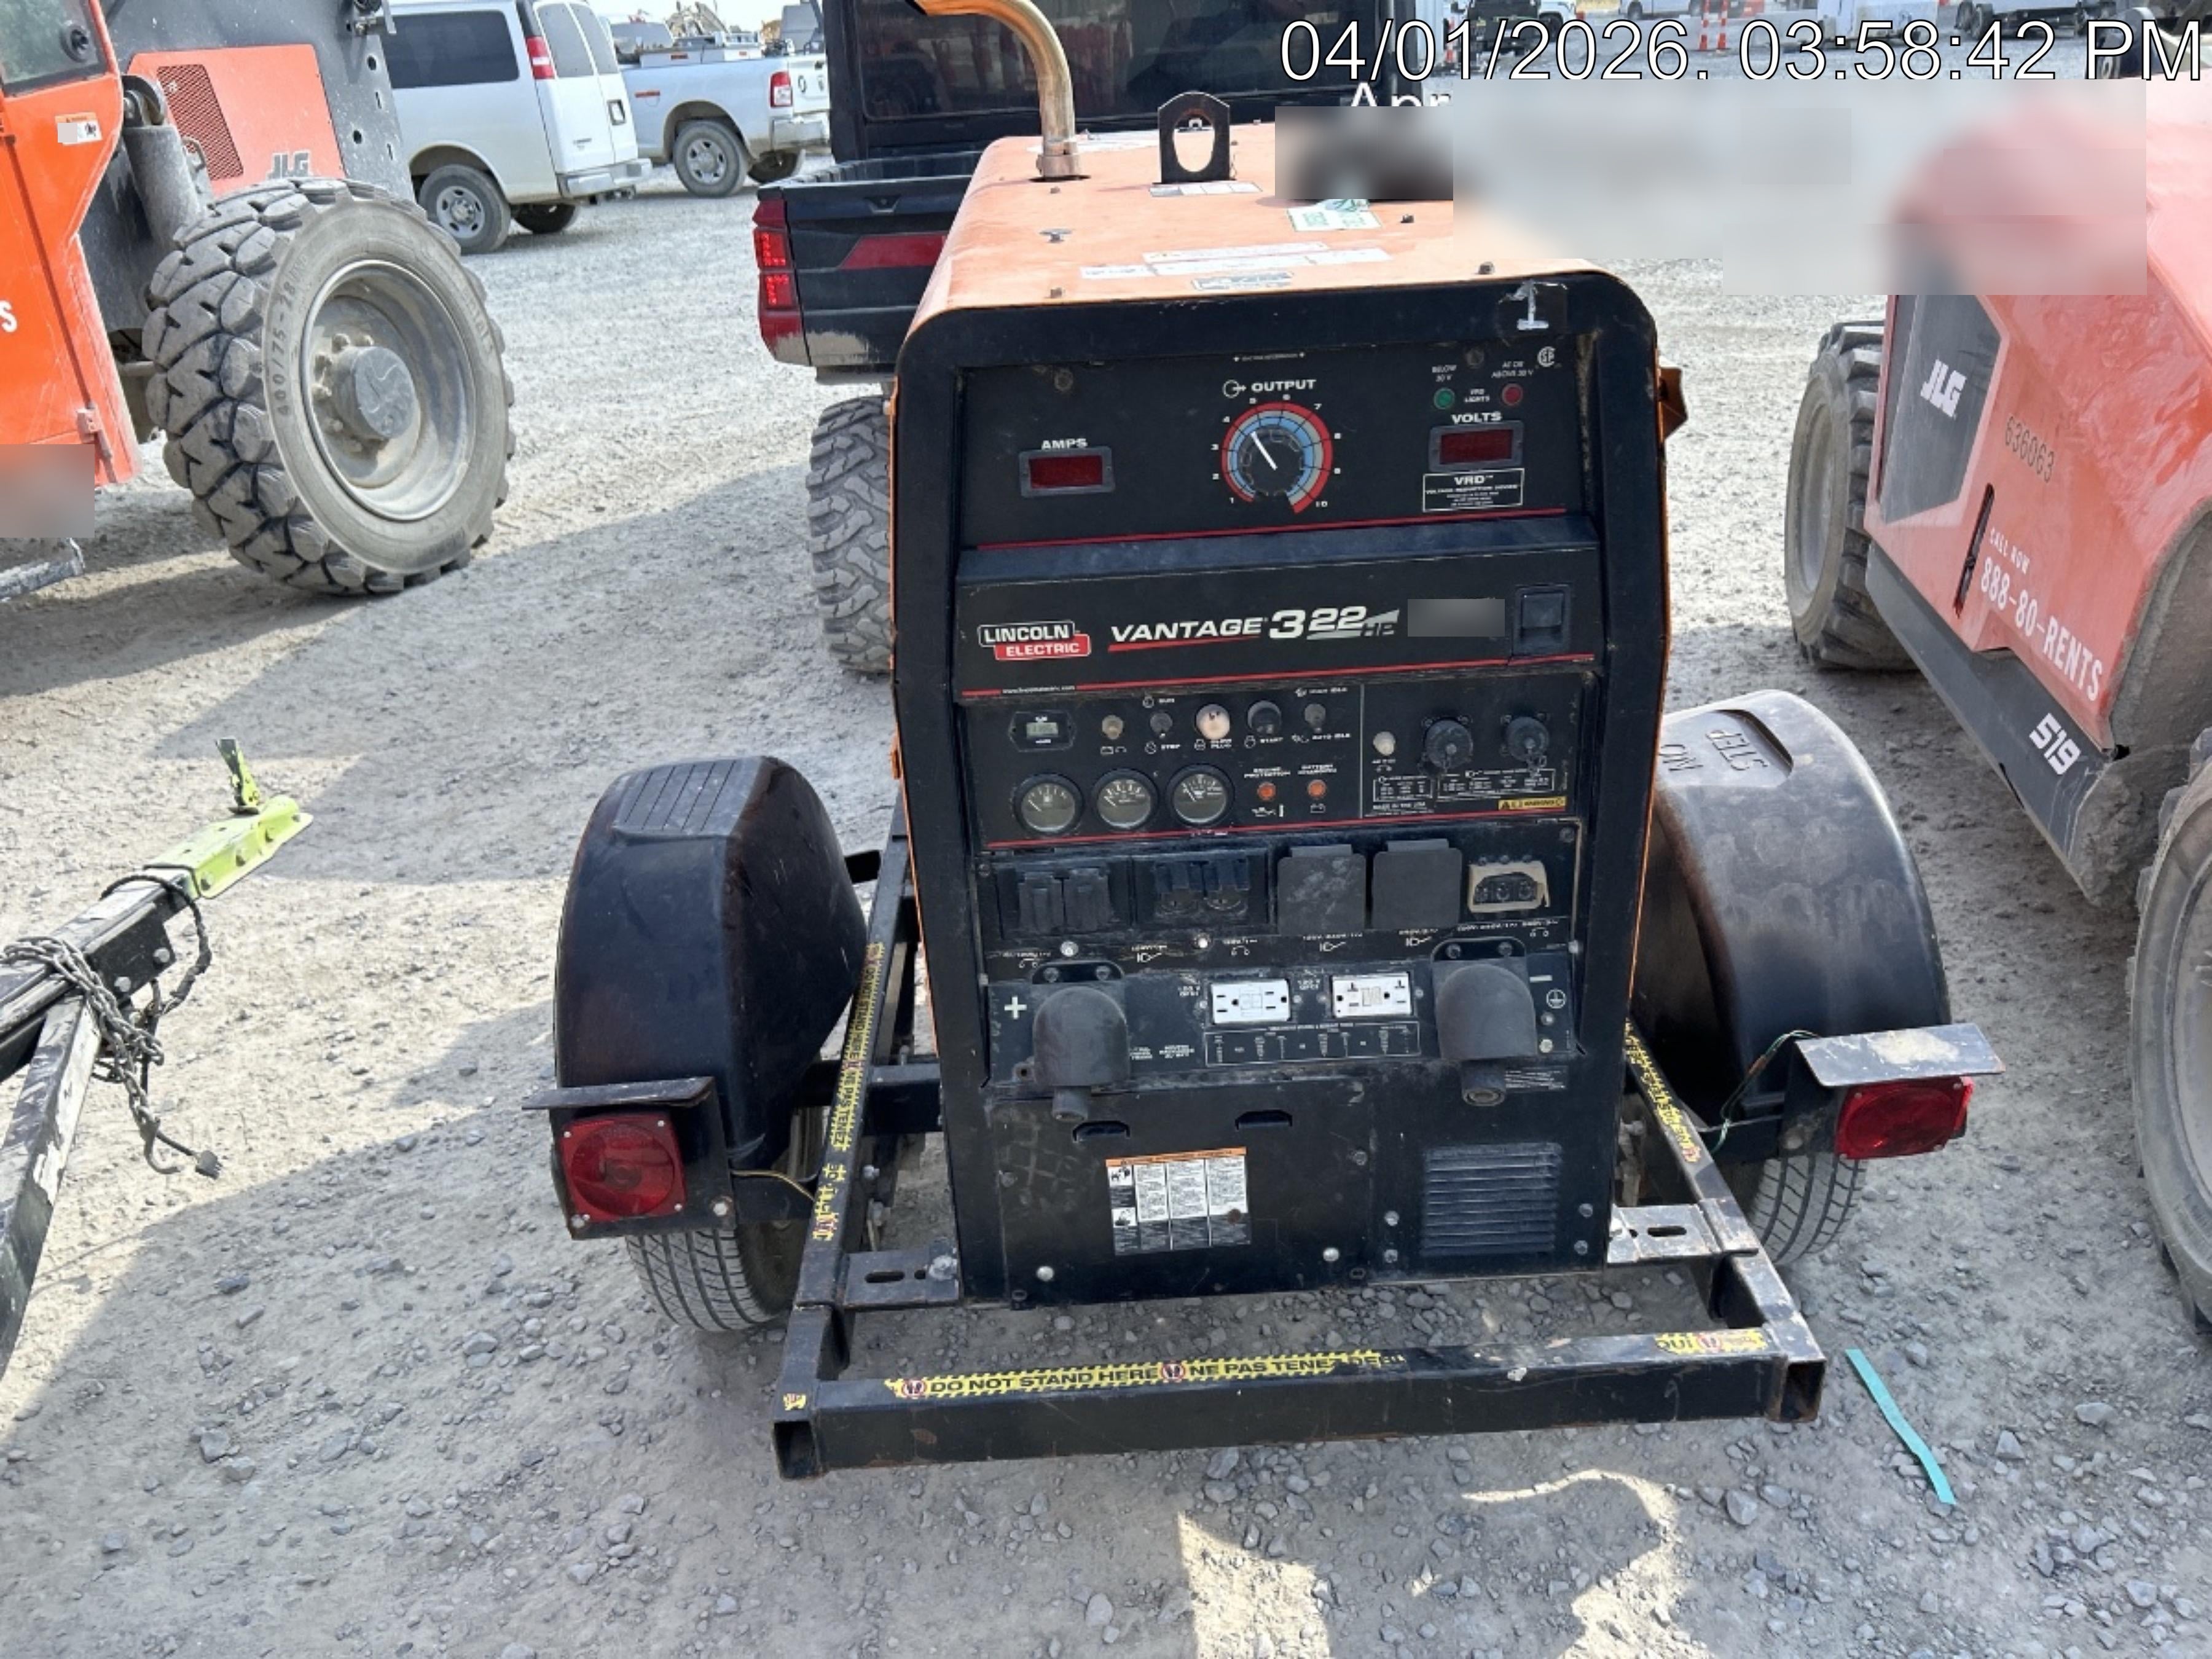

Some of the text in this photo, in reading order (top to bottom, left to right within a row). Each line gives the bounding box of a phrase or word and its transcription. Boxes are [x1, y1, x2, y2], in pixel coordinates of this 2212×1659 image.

[265, 149, 310, 179] JLG
[1251, 378, 1316, 392] OUTPUT
[1920, 359, 1967, 419] JLG
[1451, 411, 1502, 425] VOLTS
[1041, 438, 1088, 450] AMPS
[2005, 416, 2054, 484] 636063
[983, 624, 1071, 643] LINCOLN
[1110, 616, 1263, 643] VANTAGE
[1269, 605, 1367, 639] 322
[1980, 556, 2103, 702] 888-80-RENTS
[1005, 641, 1080, 657] ELECTRIC
[2029, 713, 2082, 775] 519
[930, 1381, 962, 1392] DO
[970, 1377, 1011, 1390] NOT
[1019, 1372, 1092, 1387] STAND
[1098, 1368, 1158, 1382] HERE
[1191, 1365, 1218, 1377] NE
[1225, 1360, 1268, 1375] PAS
